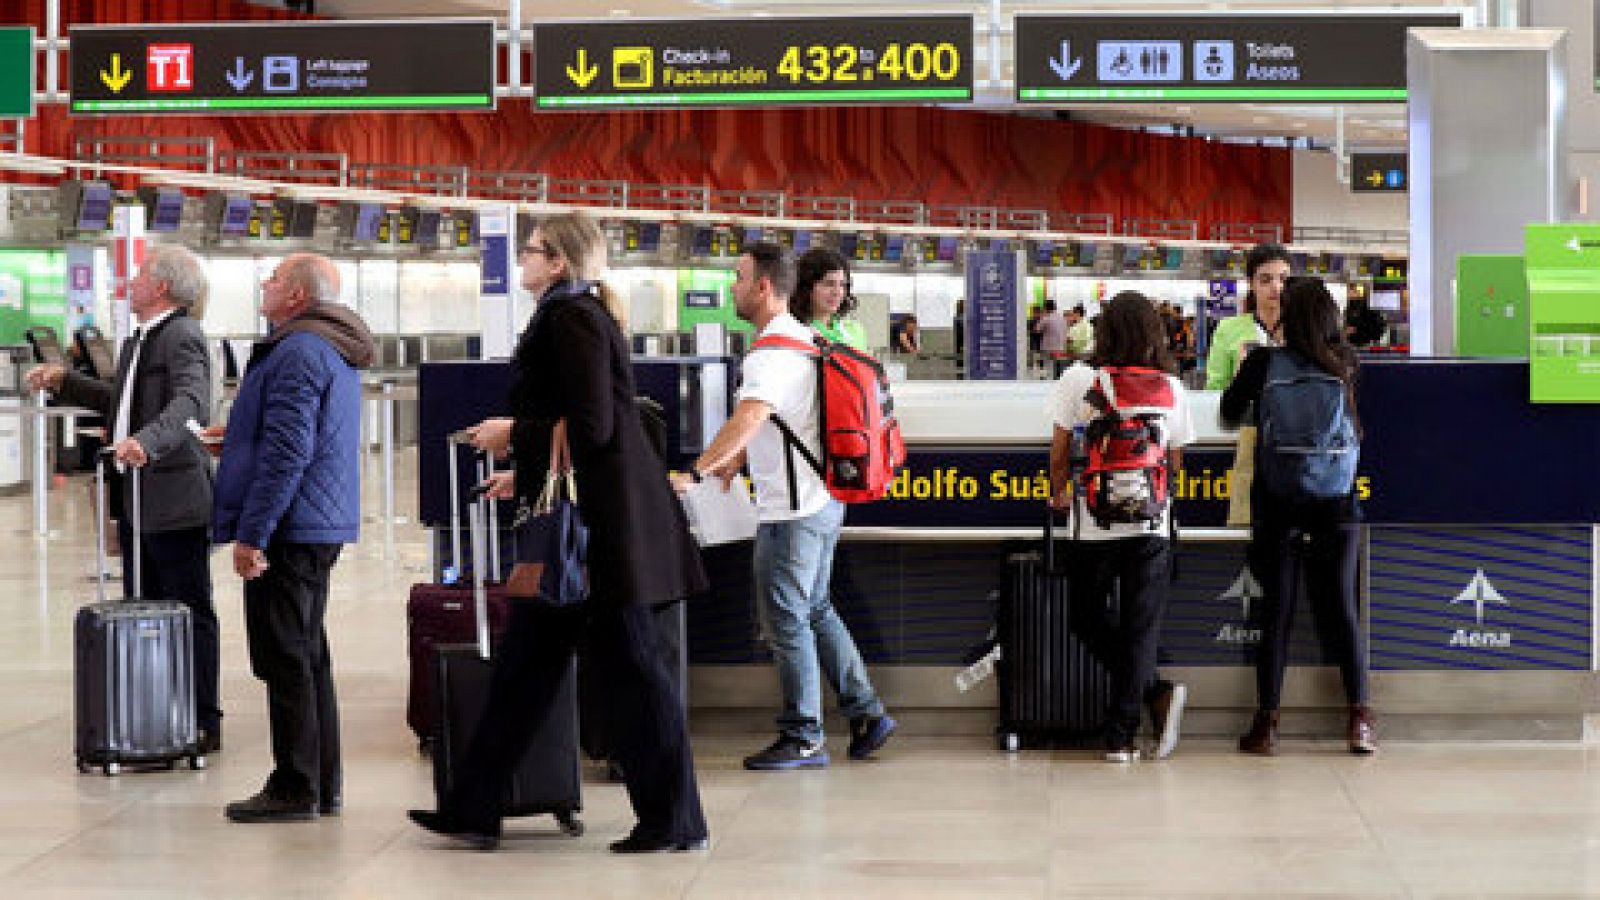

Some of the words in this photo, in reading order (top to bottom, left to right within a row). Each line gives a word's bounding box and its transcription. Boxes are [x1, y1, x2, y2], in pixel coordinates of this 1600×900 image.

[662, 47, 731, 64] Check-in
[777, 46, 857, 83] 432
[876, 43, 961, 81] 400
[149, 56, 191, 87] T1
[662, 66, 768, 85] Facturación
[884, 468, 979, 498] dolfo
[1174, 469, 1231, 498] drid
[1217, 623, 1262, 643] Aen
[1450, 629, 1511, 648] Aena
